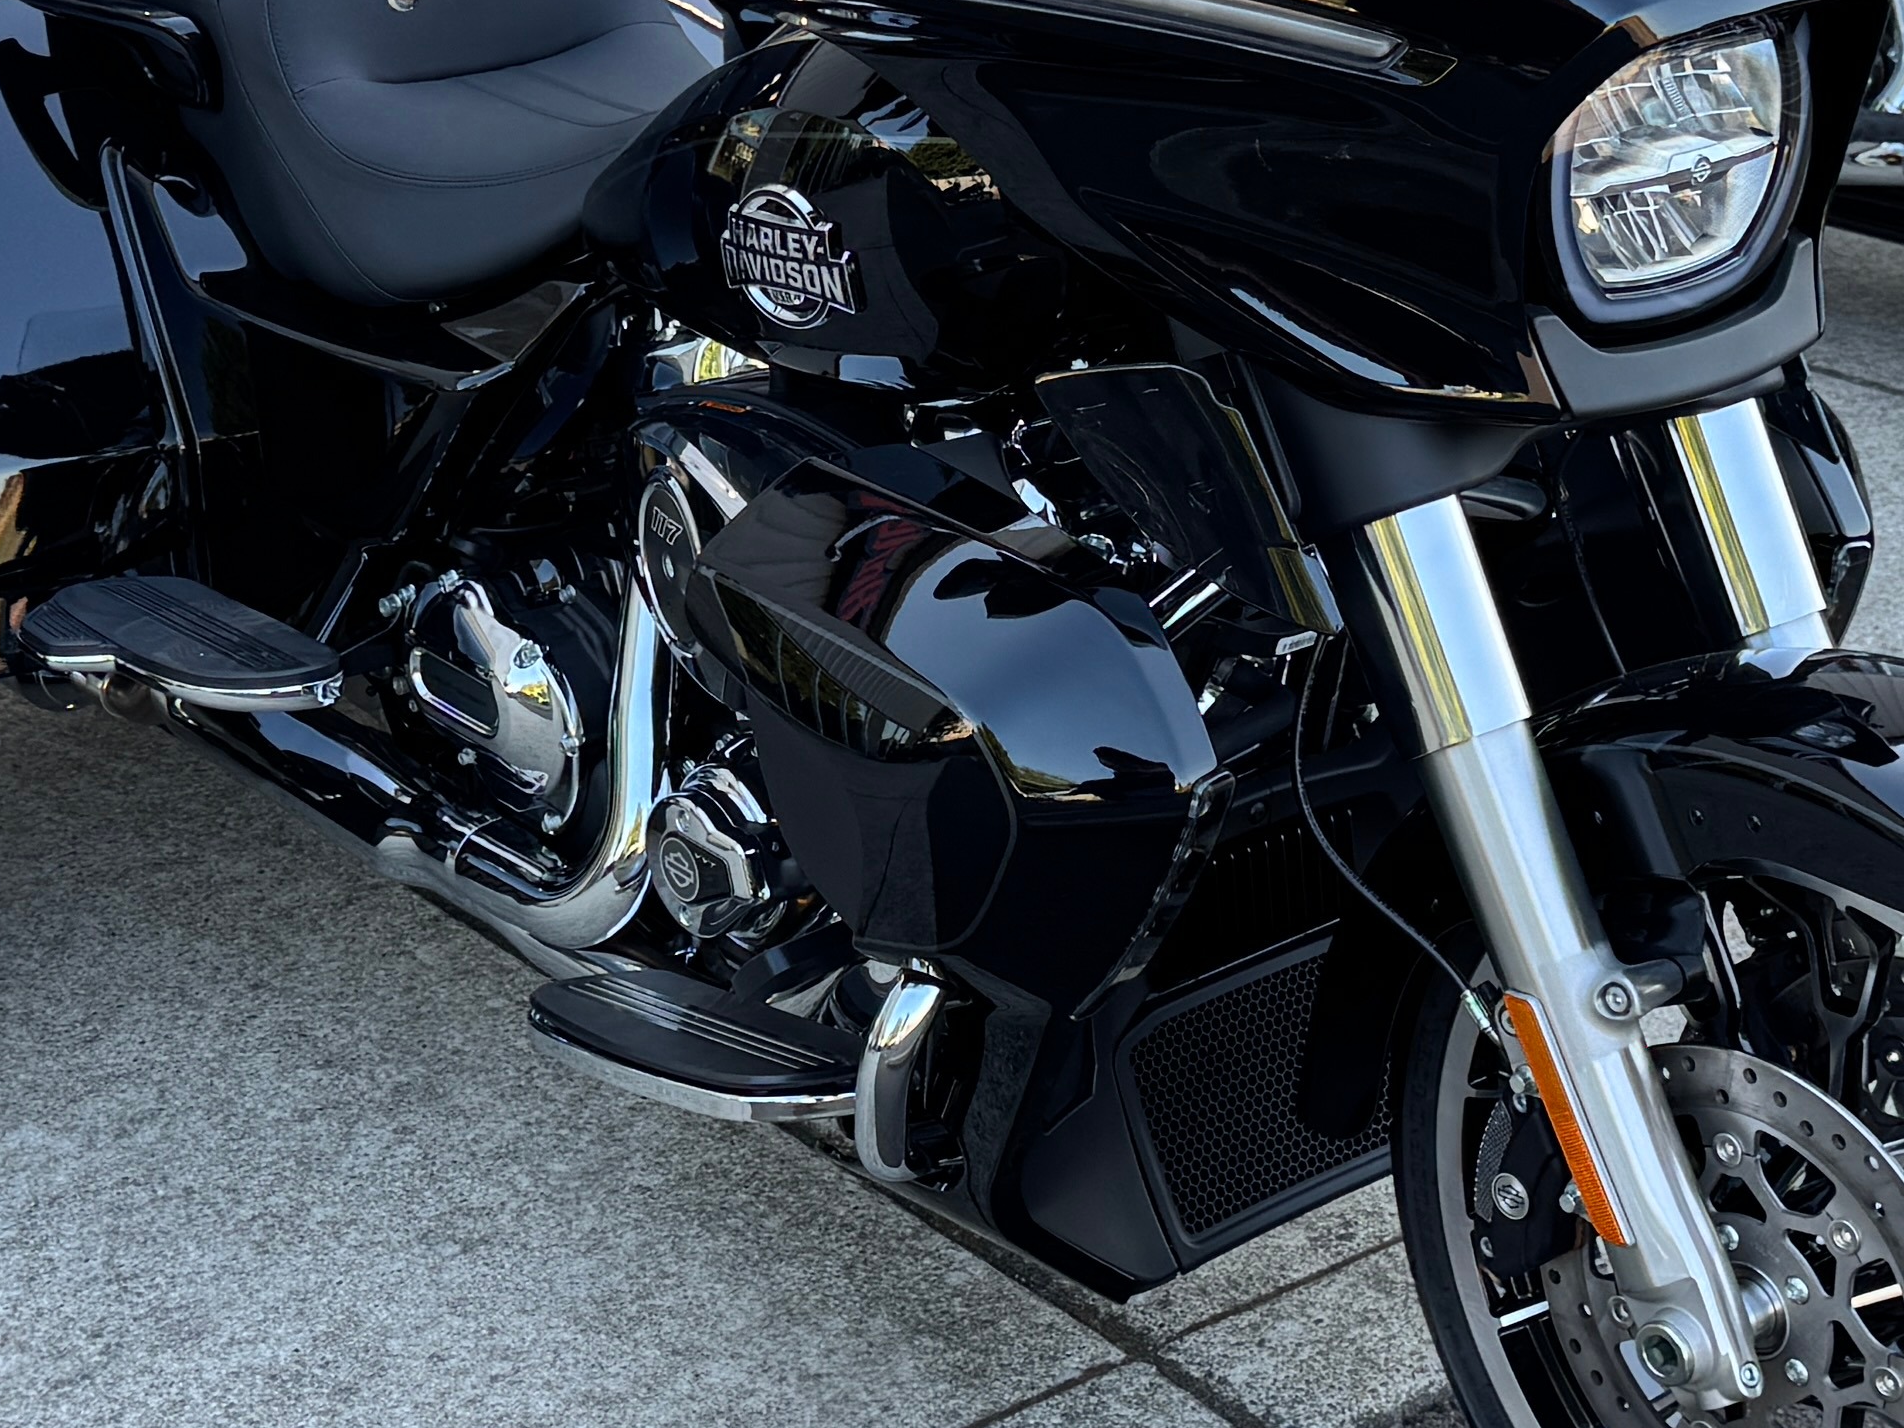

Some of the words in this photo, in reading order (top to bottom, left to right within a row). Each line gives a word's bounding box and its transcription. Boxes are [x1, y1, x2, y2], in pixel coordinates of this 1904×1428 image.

[731, 218, 825, 260] HARLEY-
[725, 244, 846, 305] DAVIDSON
[651, 506, 684, 546] 117
